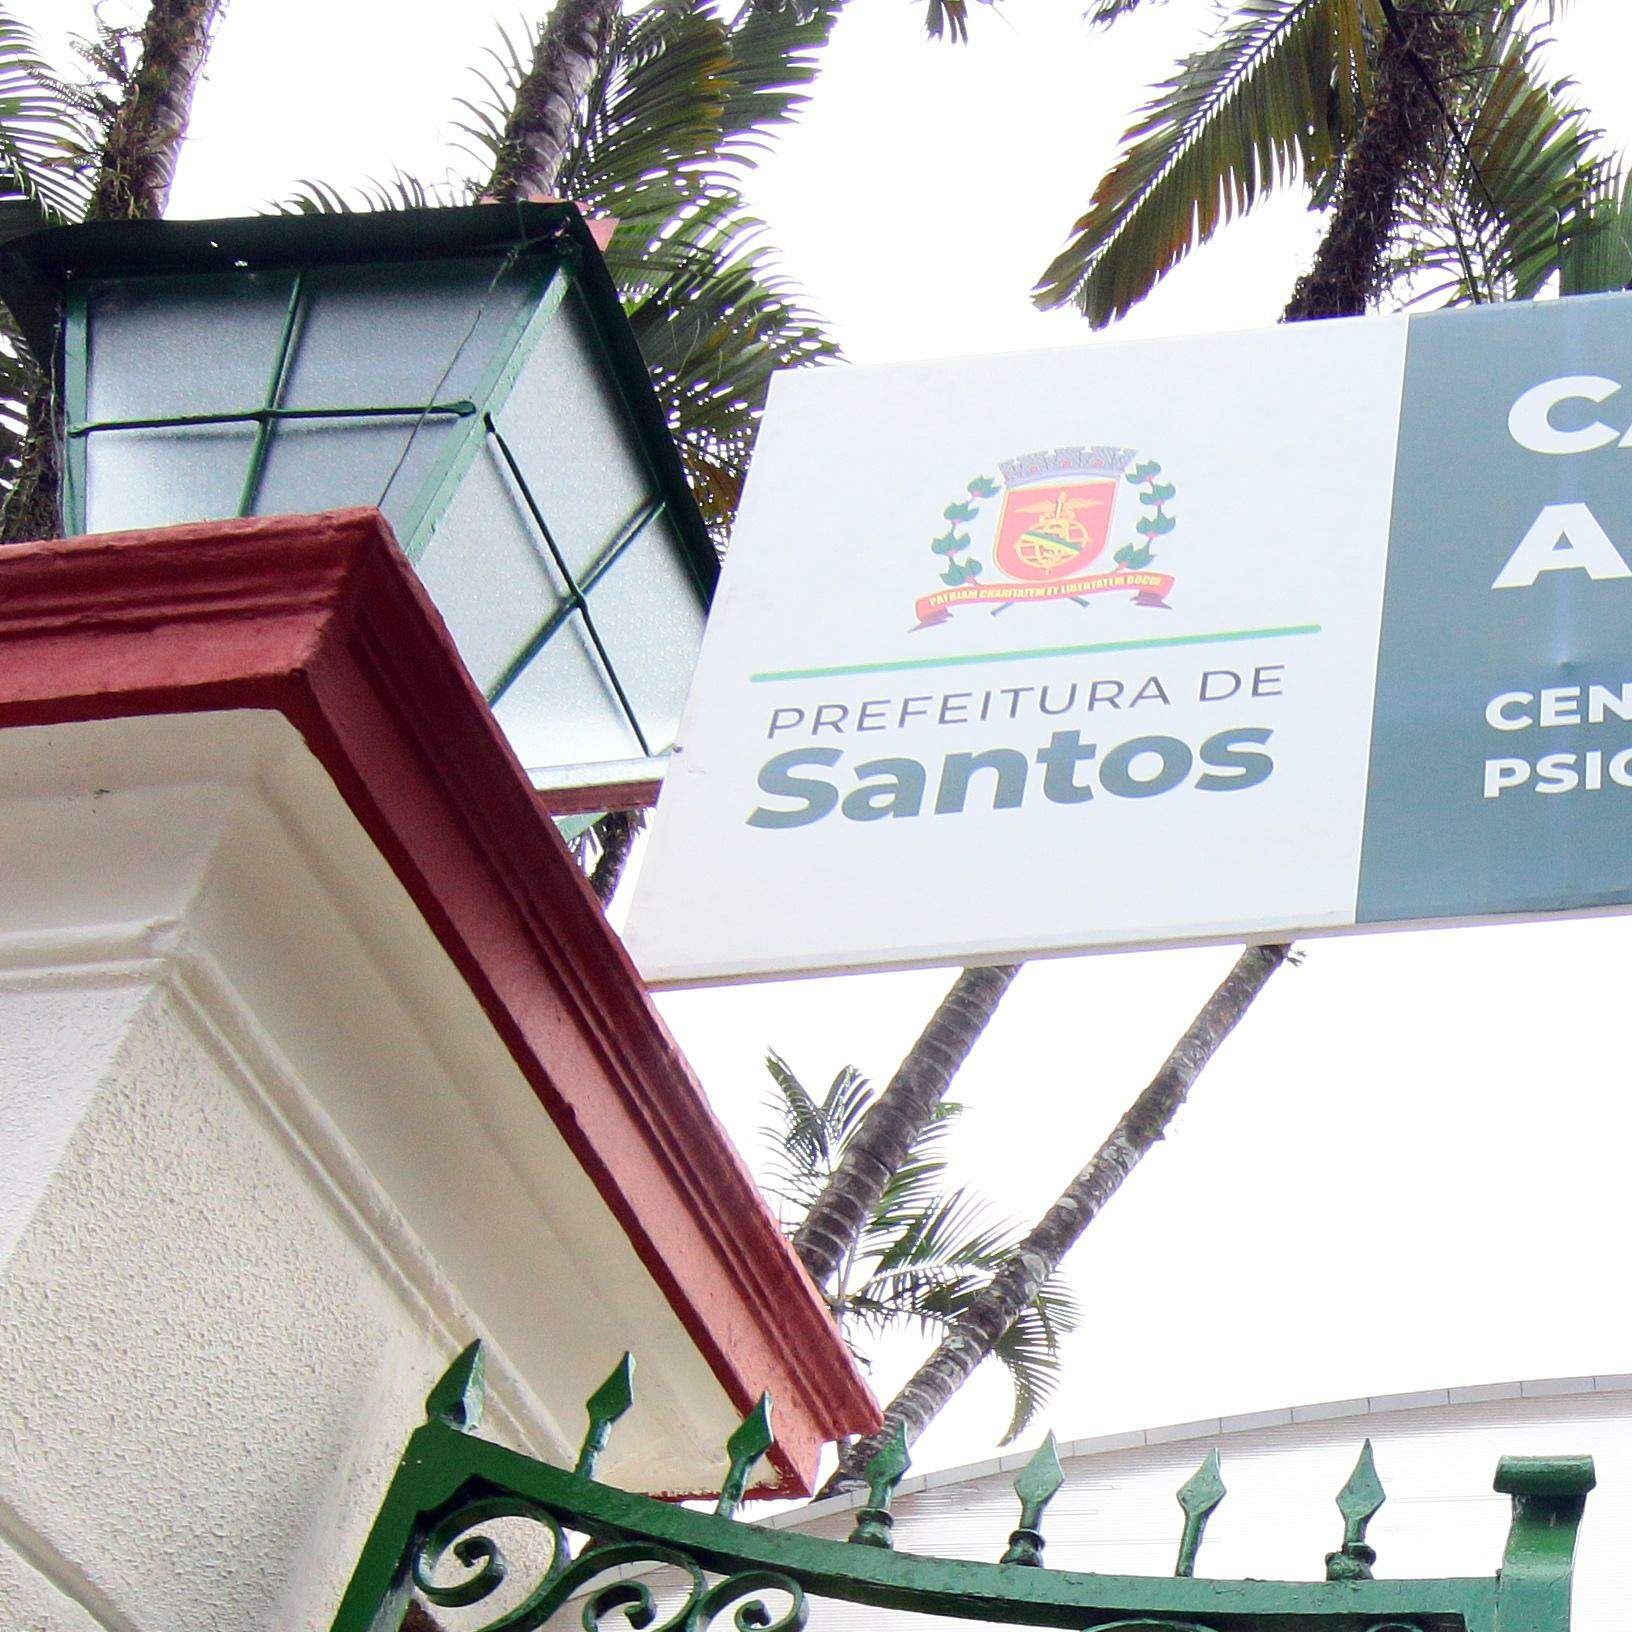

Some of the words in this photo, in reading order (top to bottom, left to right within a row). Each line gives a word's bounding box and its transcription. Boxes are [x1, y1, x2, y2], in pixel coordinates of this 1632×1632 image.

[767, 676, 1170, 740] PREFEITURA
[1198, 665, 1287, 704] DE
[745, 726, 1275, 830] Santos
